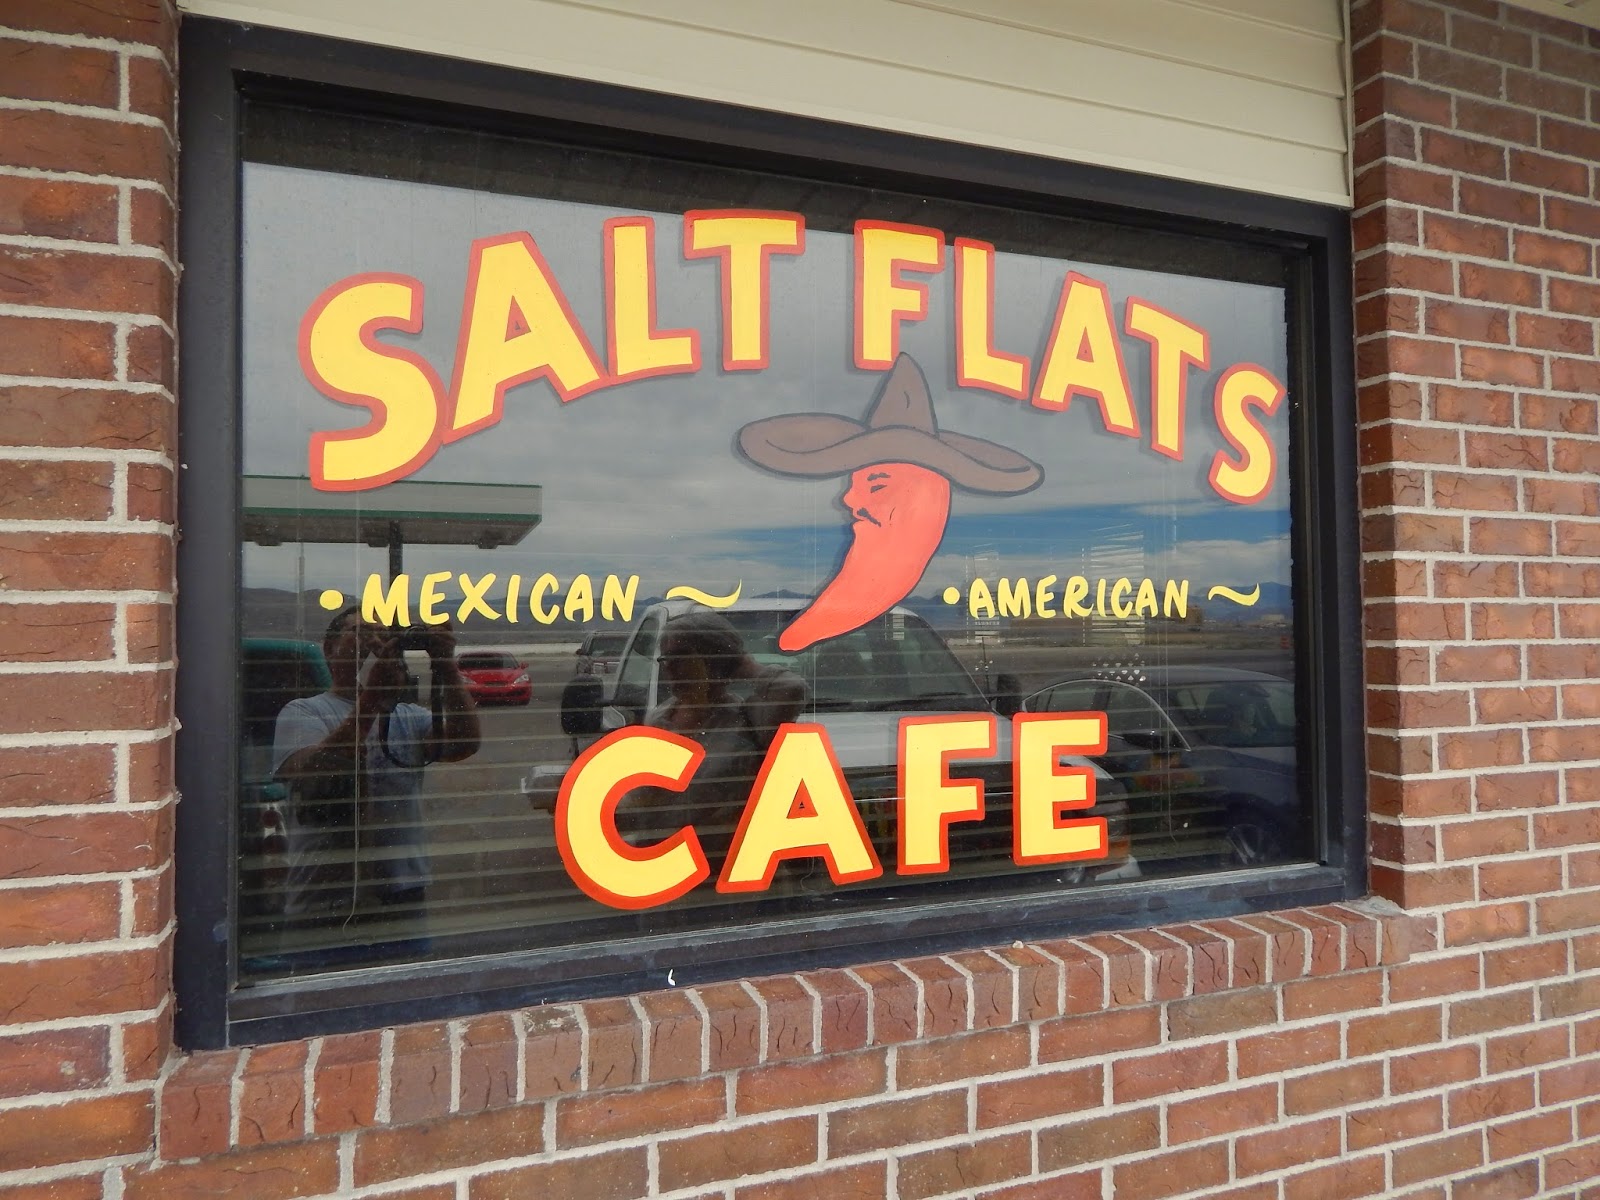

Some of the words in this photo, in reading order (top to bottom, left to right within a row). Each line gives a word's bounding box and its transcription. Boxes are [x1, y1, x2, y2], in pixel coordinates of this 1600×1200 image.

[298, 209, 806, 492] SALT
[853, 219, 1286, 505] FLATS
[361, 571, 640, 627] MEXICAN
[968, 574, 1190, 620] AMERICAN
[554, 710, 1109, 910] CAFE
